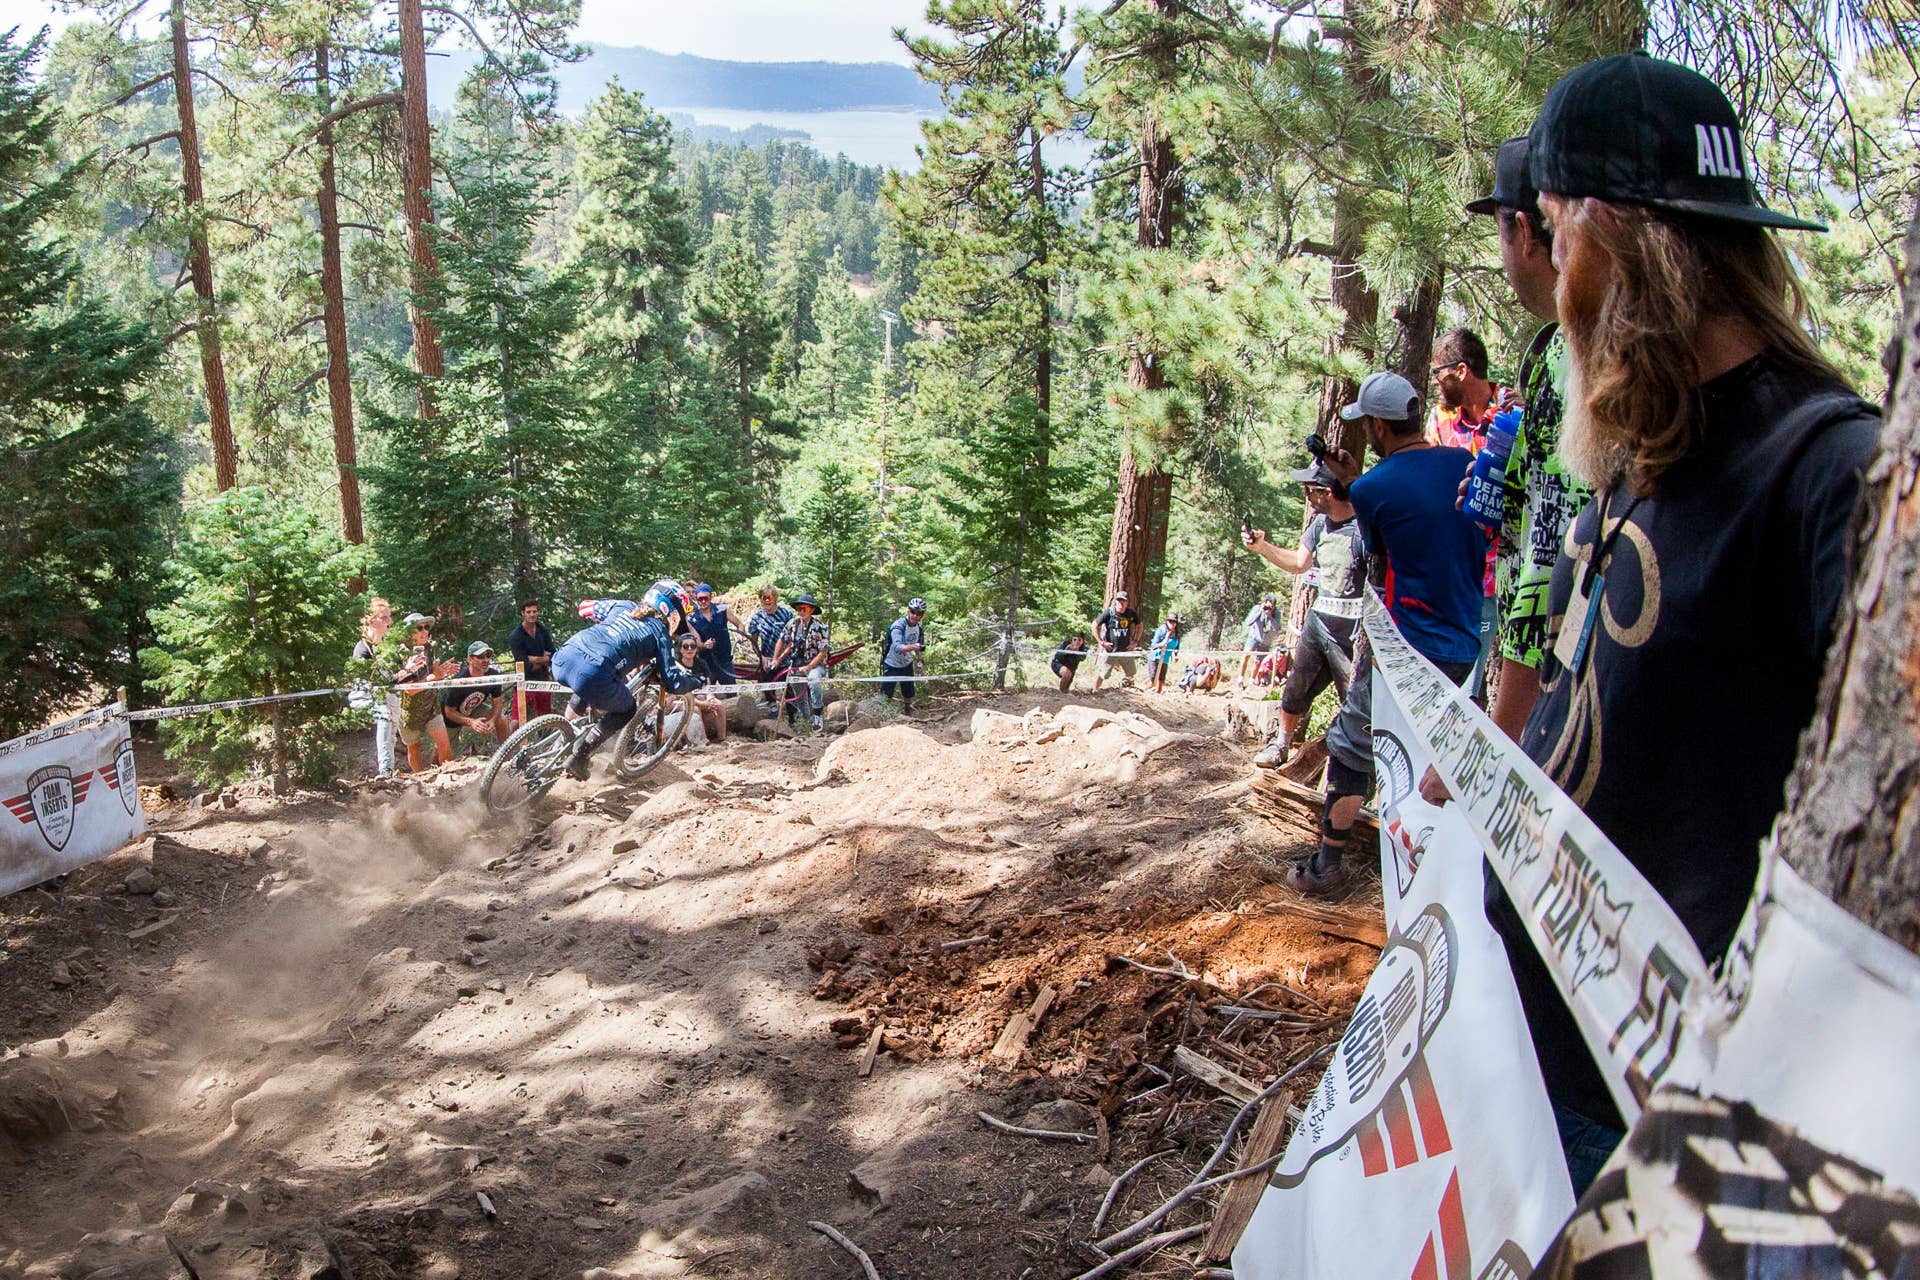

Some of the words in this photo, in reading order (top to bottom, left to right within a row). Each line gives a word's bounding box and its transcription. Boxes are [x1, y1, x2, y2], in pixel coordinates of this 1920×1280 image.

[1695, 123, 1741, 178] ALL
[1473, 475, 1503, 496] DEF
[1469, 499, 1482, 512] AND
[1476, 490, 1505, 511] GRAV
[1113, 628, 1128, 637] WV
[43, 782, 61, 800] FOAM
[41, 795, 68, 817] INSERTS
[1427, 700, 1466, 752] FOX
[1452, 727, 1493, 796] FOX
[1484, 768, 1538, 859] FOX
[1532, 831, 1602, 961] FOX
[1608, 943, 1689, 1113] FO
[1343, 994, 1386, 1104] INSERTS
